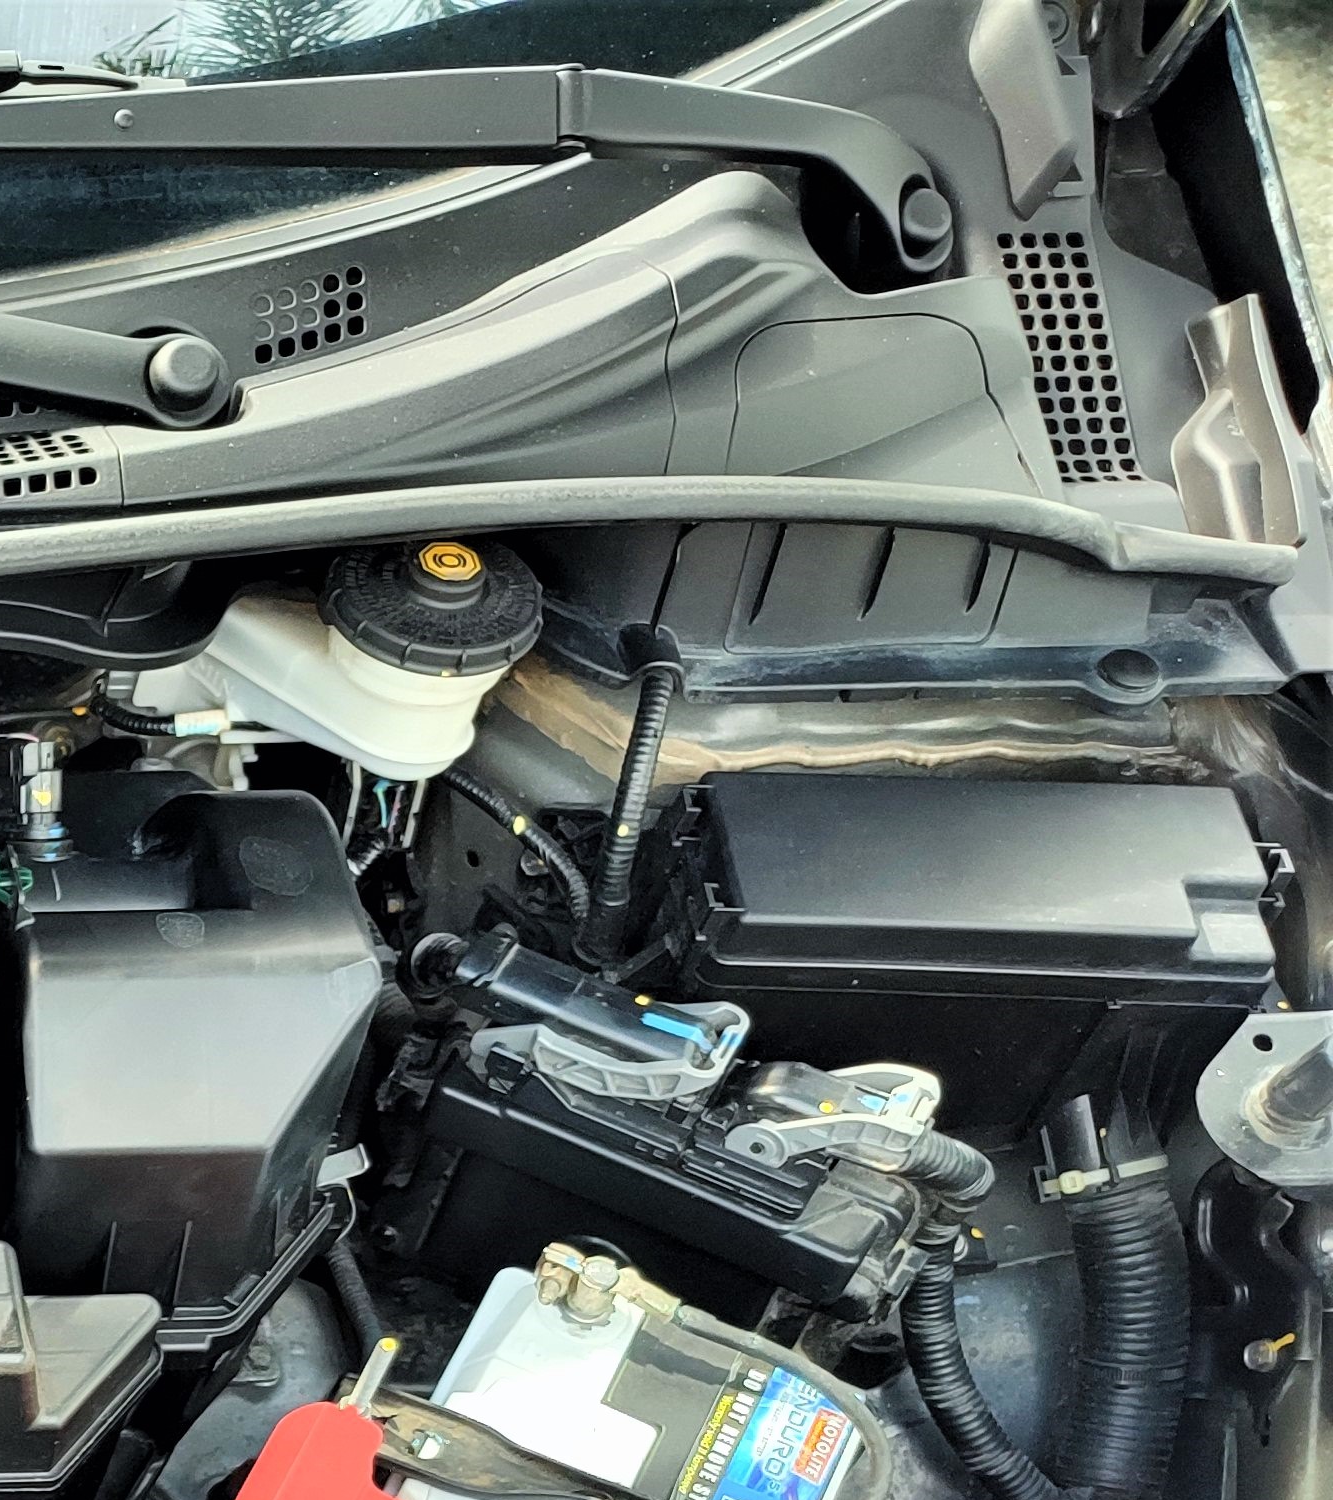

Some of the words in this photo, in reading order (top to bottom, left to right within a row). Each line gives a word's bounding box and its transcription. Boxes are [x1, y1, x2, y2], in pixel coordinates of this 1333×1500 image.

[726, 1391, 756, 1425] NOT
[742, 1368, 768, 1394] DO
[697, 1422, 740, 1484] REMOVE
[762, 1382, 819, 1478] ENDURO
[803, 1414, 849, 1478] MOTOLITE
